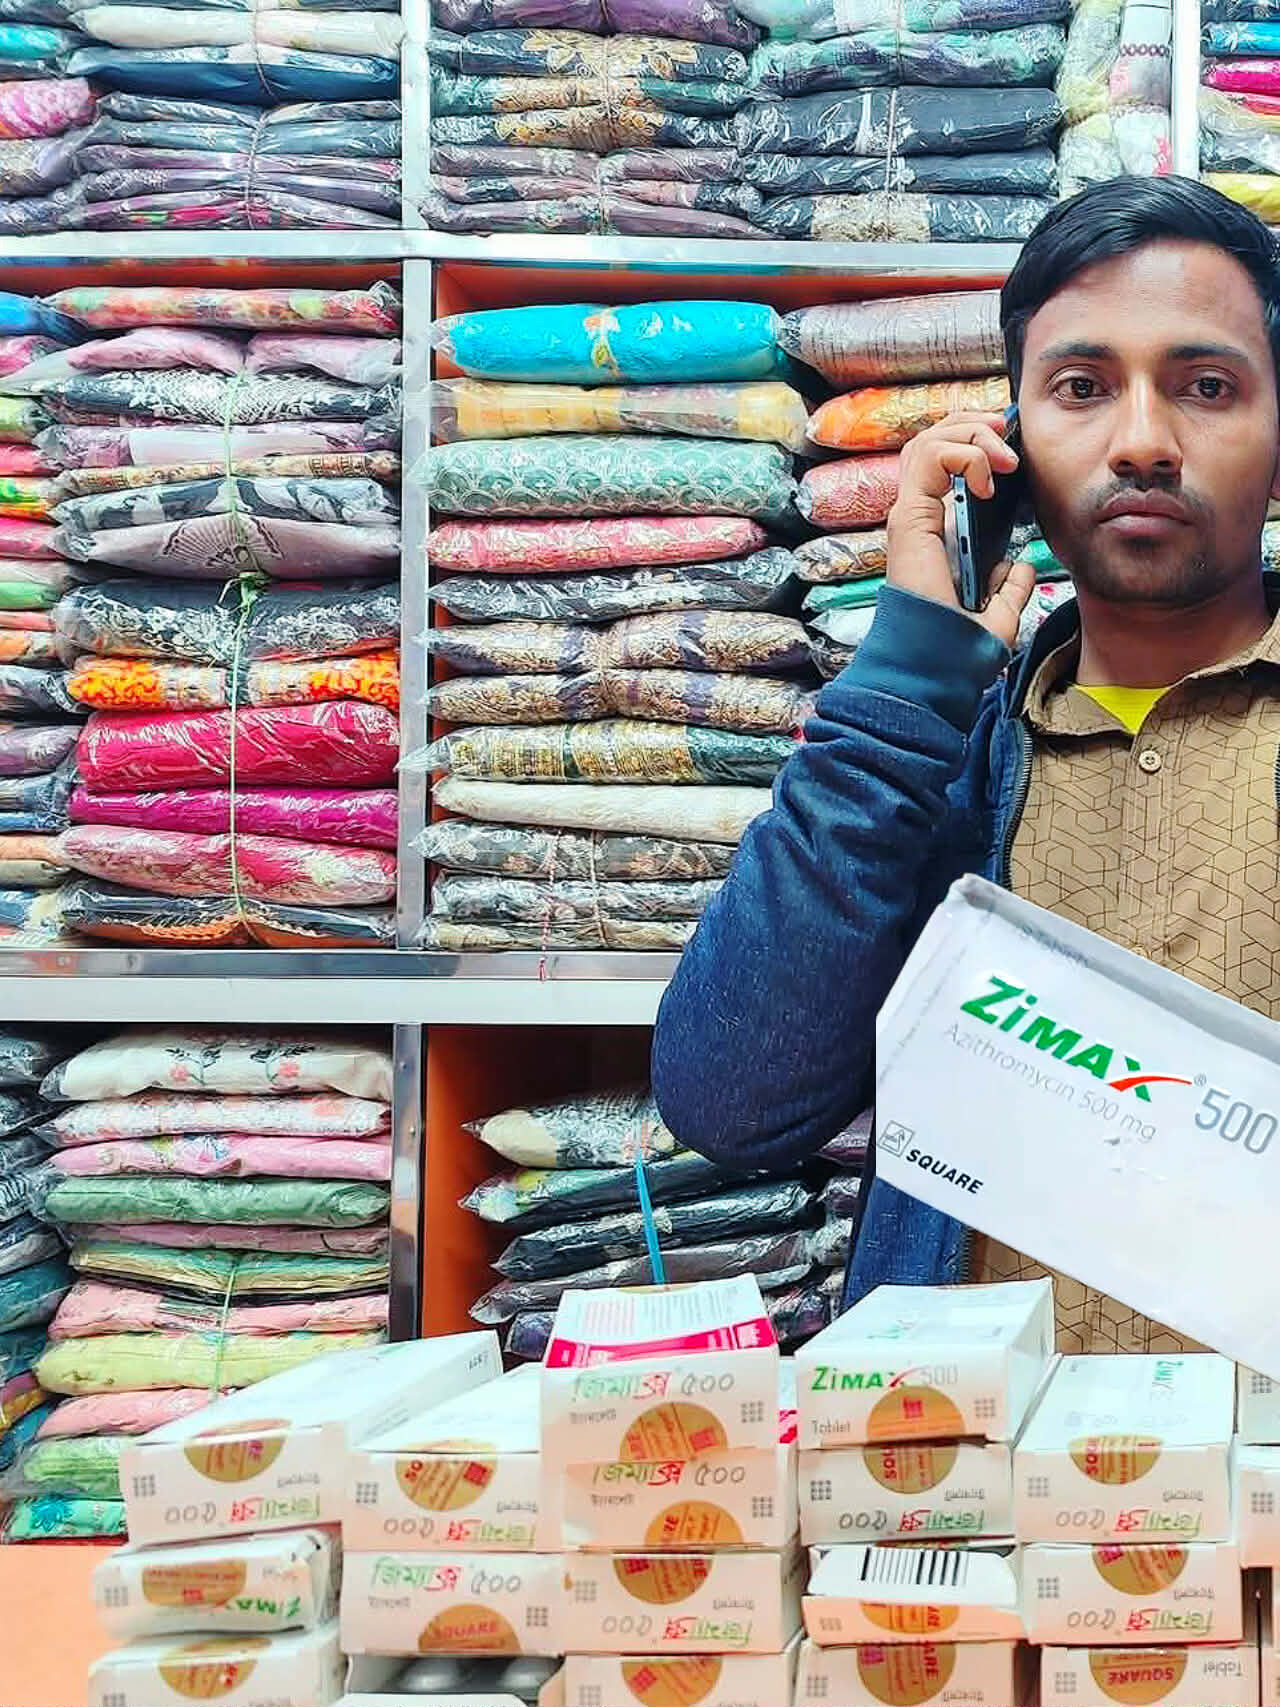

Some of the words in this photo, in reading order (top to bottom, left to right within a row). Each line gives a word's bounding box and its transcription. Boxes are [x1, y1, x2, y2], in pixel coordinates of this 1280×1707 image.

[944, 1023, 1075, 1101] Azithromycin
[1077, 1089, 1119, 1121] 500
[1120, 1113, 1157, 1143] mg
[1194, 1087, 1278, 1155] 500
[905, 1149, 984, 1196] SQUARE
[1107, 1667, 1175, 1686] SQUARE
